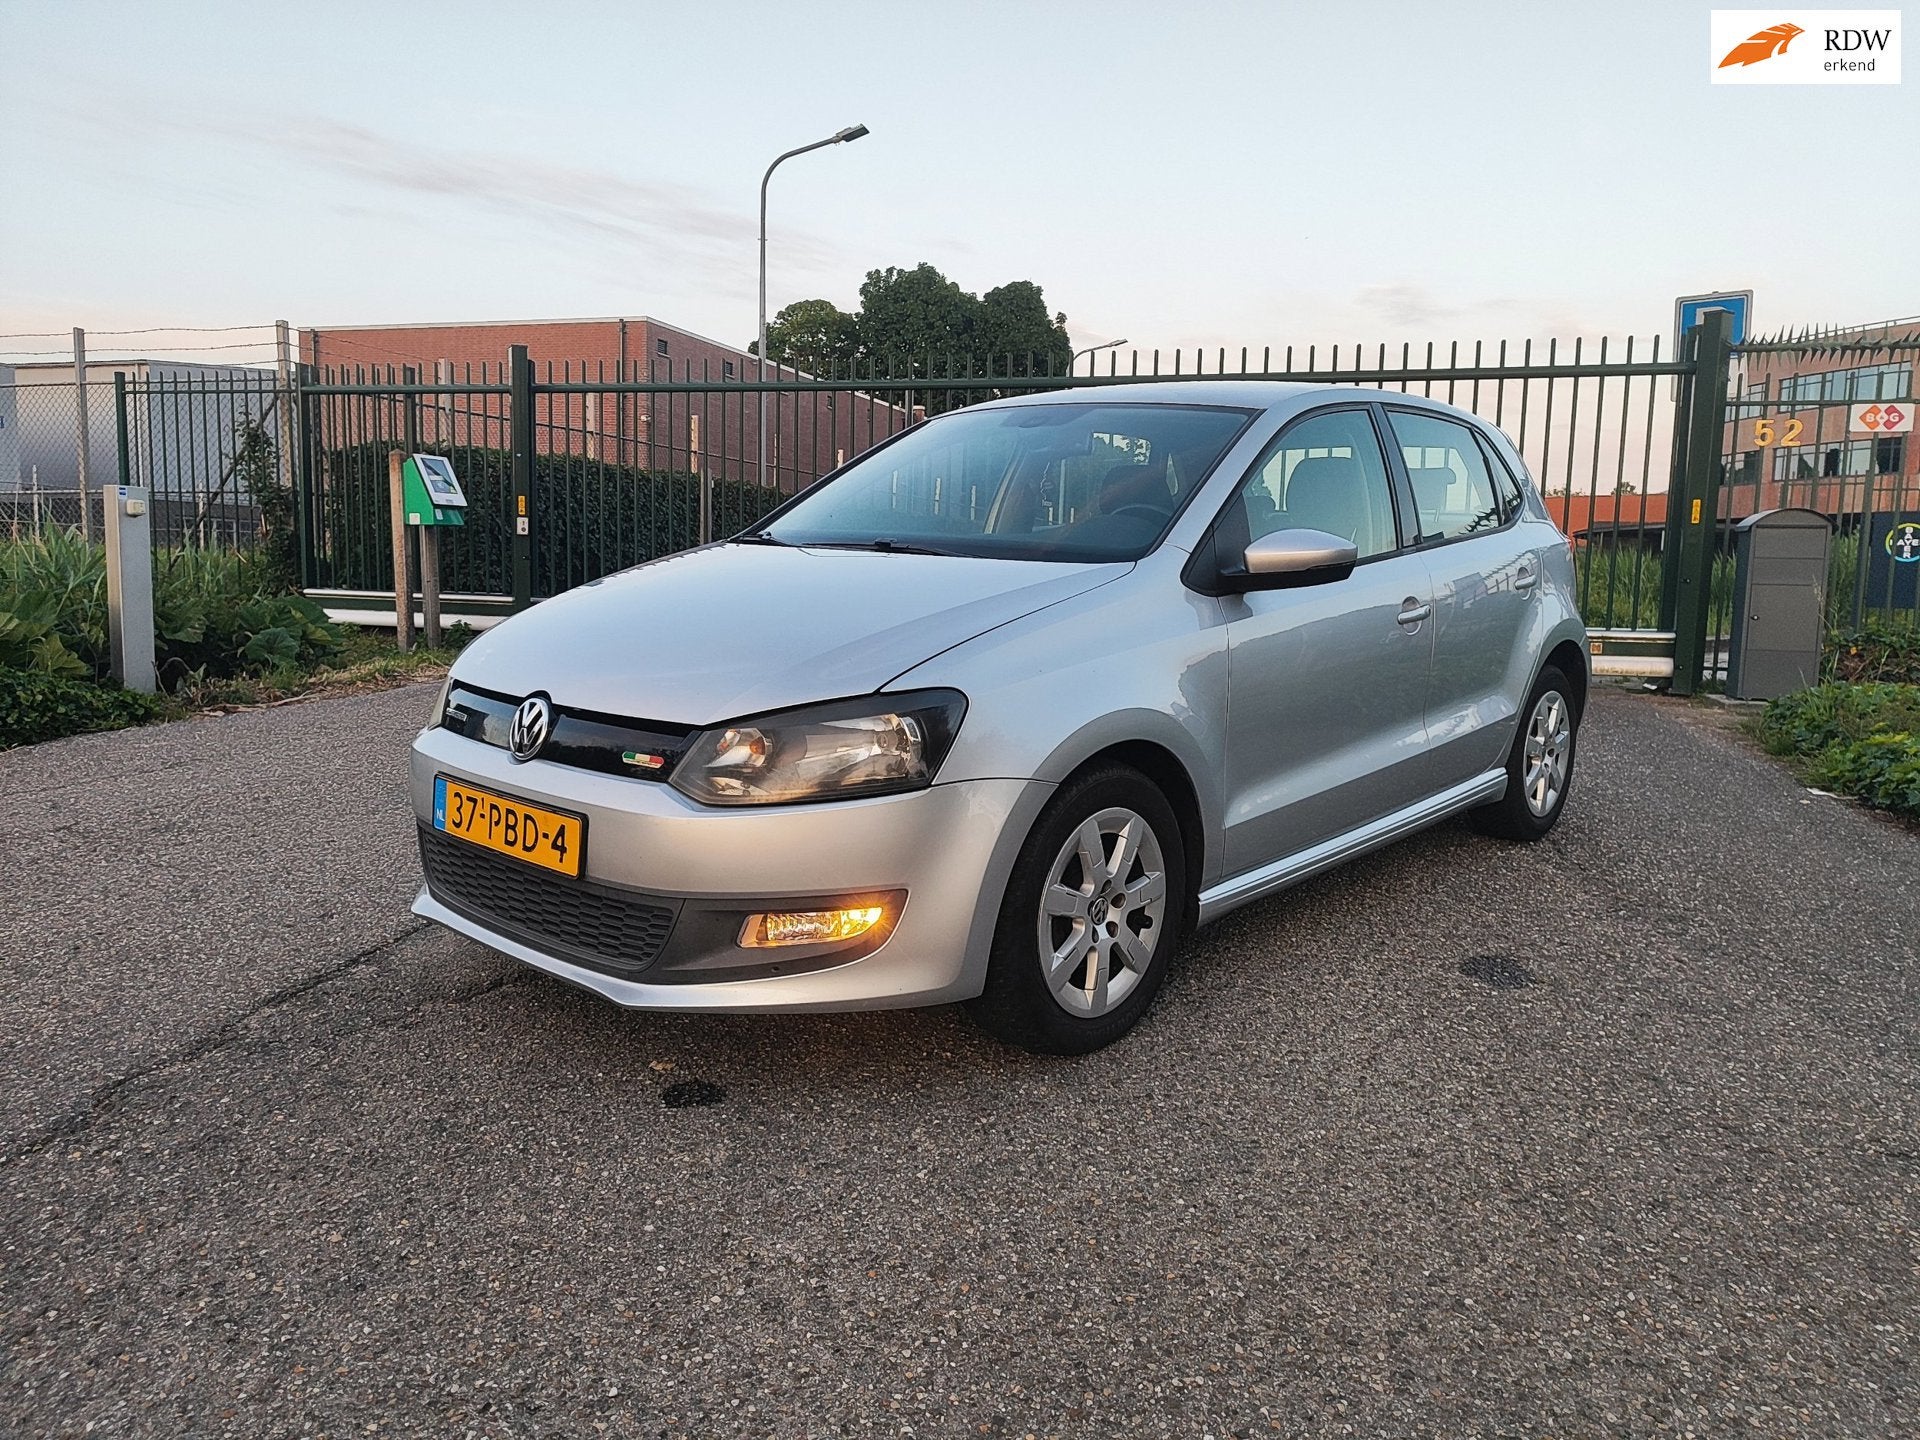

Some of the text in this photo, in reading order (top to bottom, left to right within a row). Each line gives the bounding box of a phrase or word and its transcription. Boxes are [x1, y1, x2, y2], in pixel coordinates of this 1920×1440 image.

[1754, 419, 1804, 447] 52
[1903, 526, 1914, 559] BAYER
[436, 808, 446, 822] NL
[451, 791, 568, 864] 37-PBD-4
